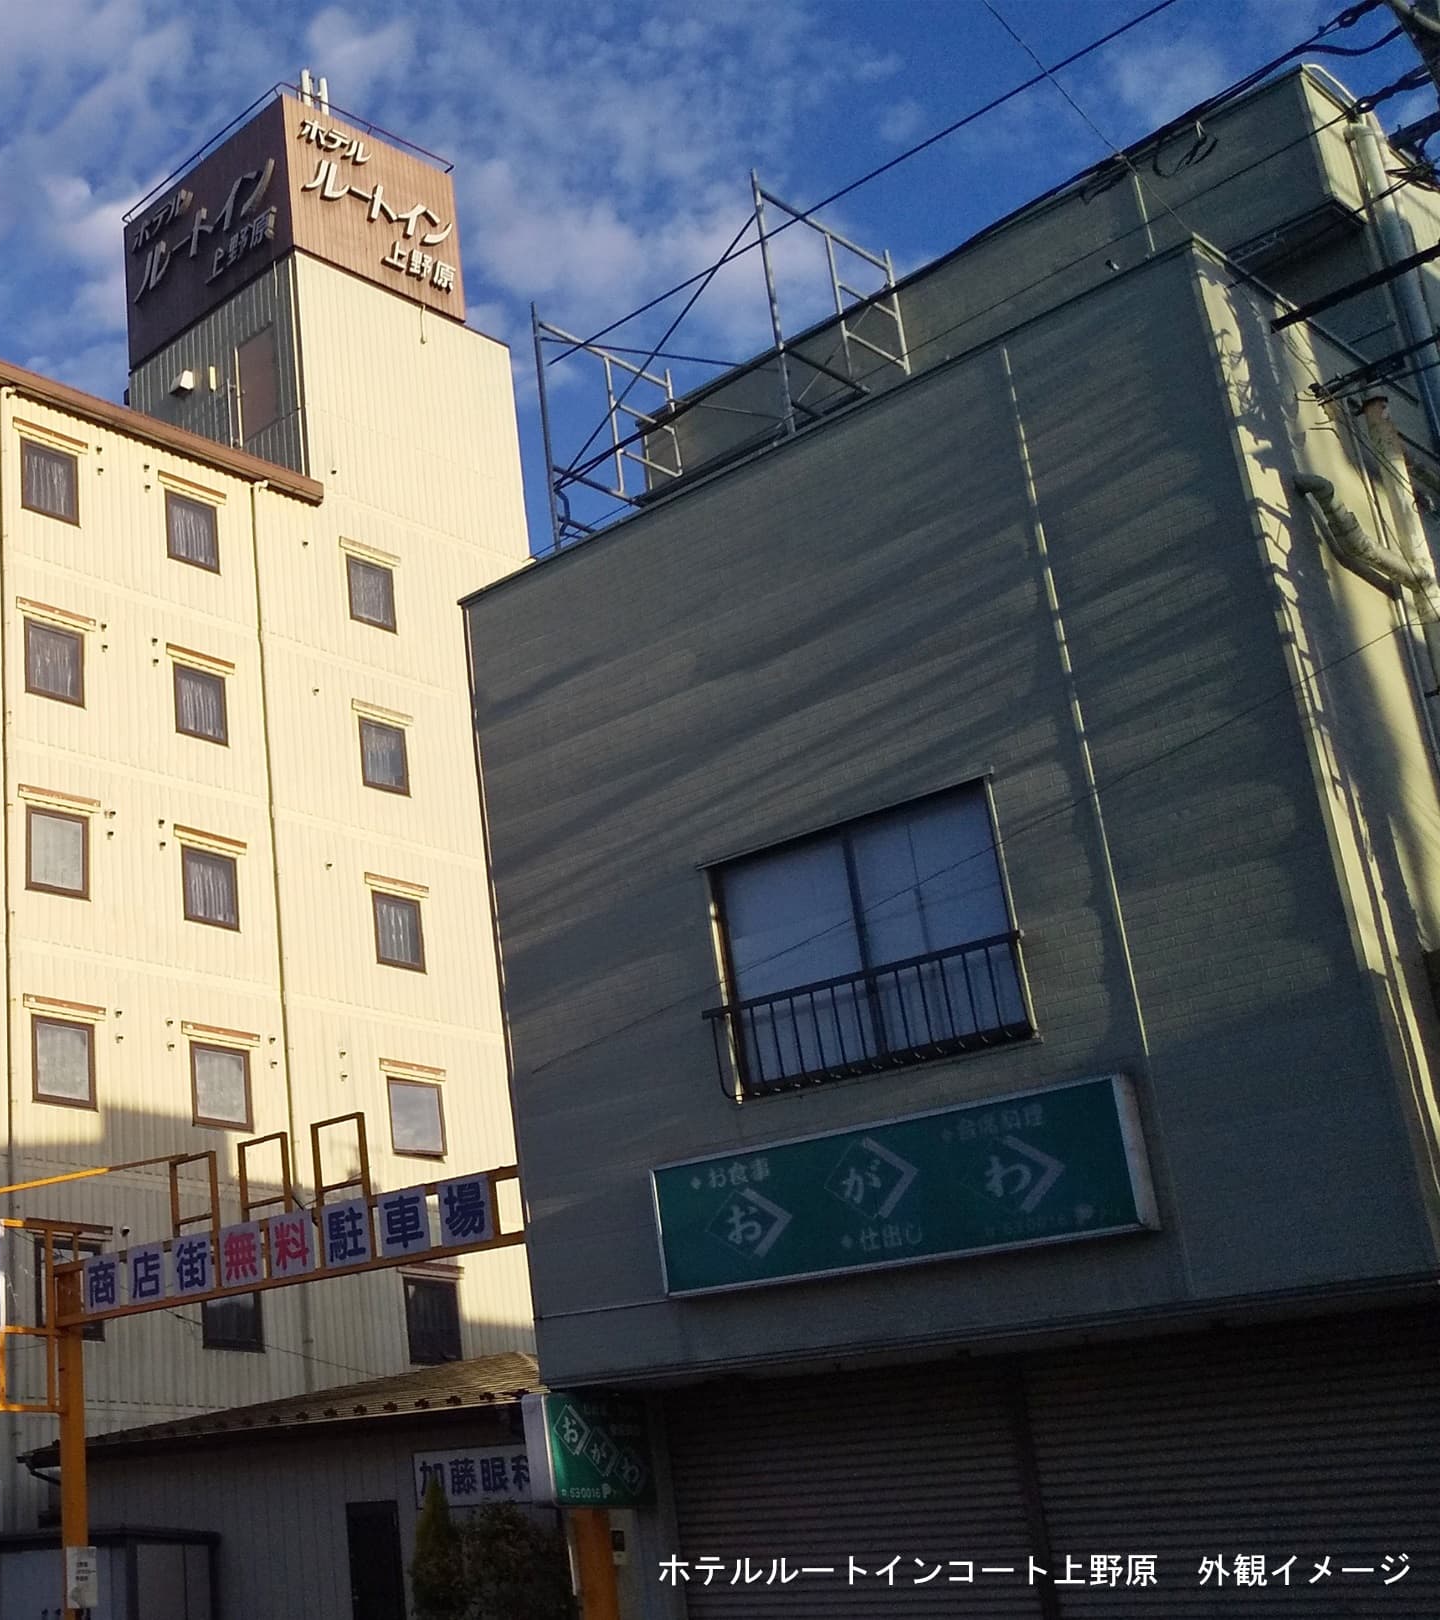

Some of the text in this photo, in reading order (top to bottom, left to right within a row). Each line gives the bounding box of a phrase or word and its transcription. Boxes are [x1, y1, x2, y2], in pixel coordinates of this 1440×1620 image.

[297, 119, 372, 166] ホテル
[132, 188, 194, 255] ホテル
[133, 157, 276, 303] ルートイン
[301, 158, 453, 247] ルートイン
[205, 206, 278, 285] 上野原
[381, 240, 458, 294] 上野原
[708, 1157, 771, 1190] お食事
[88, 1180, 486, 1309] 商店街無料駐車場
[859, 1223, 924, 1253] 仕出し
